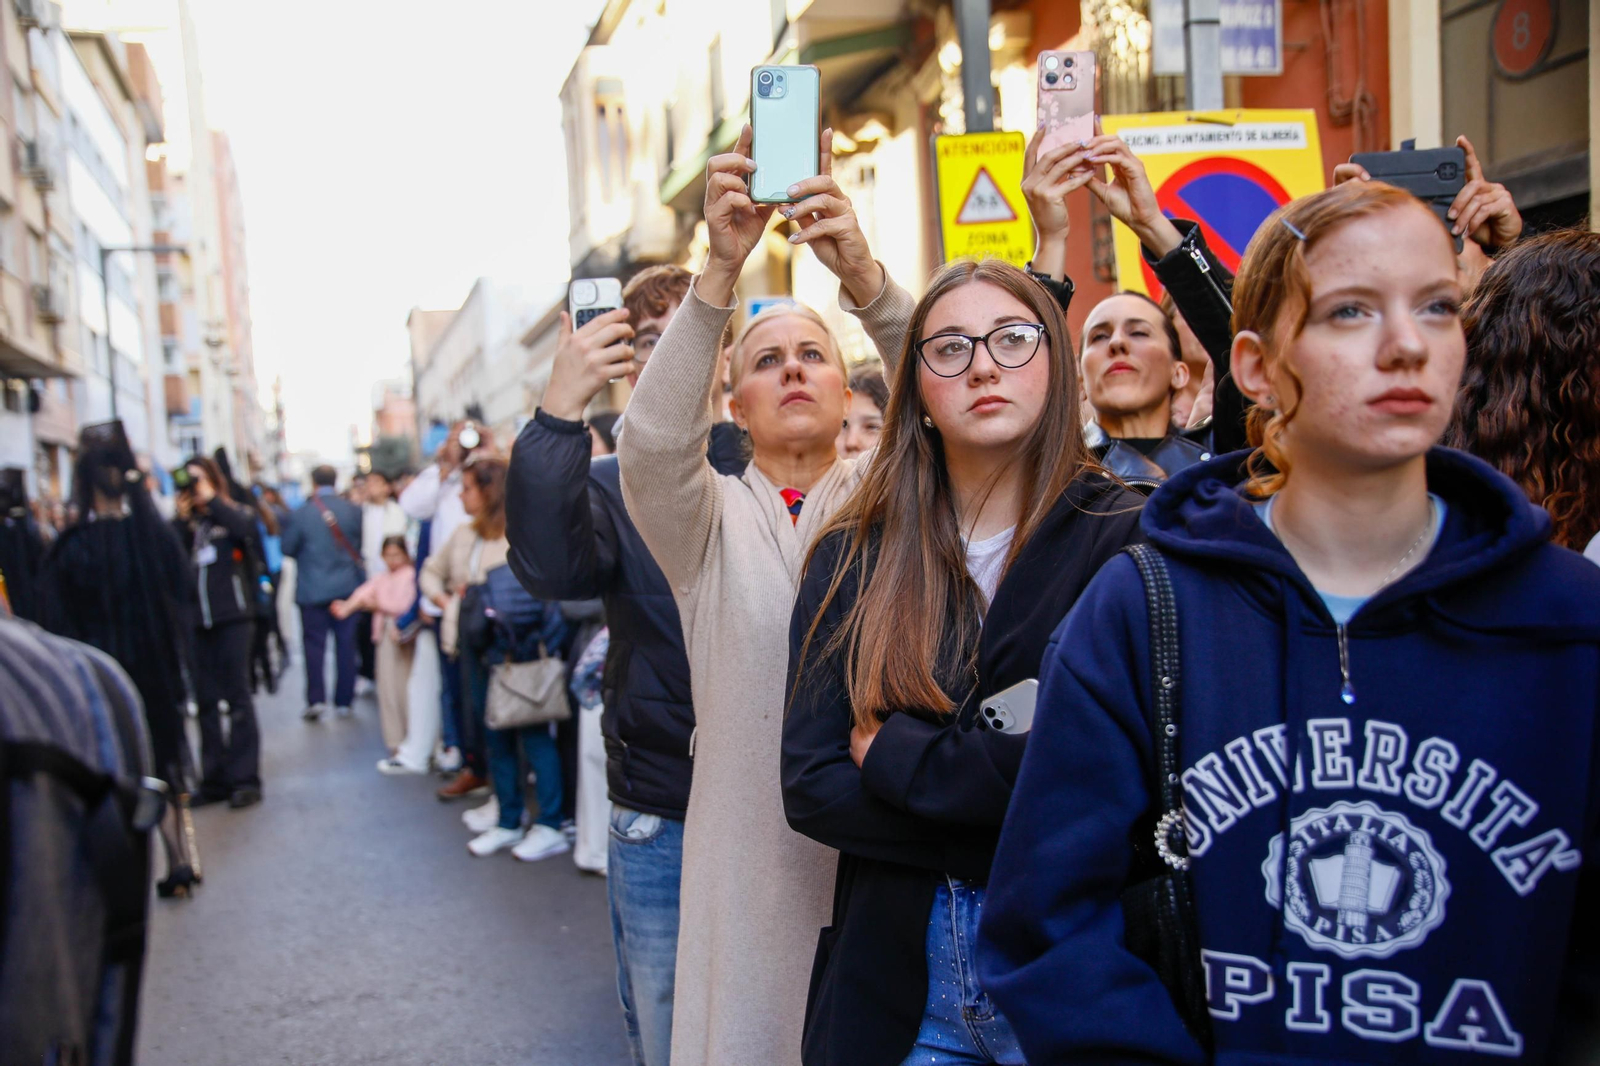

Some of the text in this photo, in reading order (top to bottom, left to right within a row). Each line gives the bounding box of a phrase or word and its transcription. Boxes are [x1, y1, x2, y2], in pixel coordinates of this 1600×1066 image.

[1512, 11, 1530, 50] 8
[1166, 130, 1241, 145] AYUNTAMIENTO
[1246, 130, 1258, 142] DE
[967, 231, 1008, 247] ZONA
[1299, 813, 1408, 854] ITALIA
[1312, 915, 1394, 945] PISA
[1200, 947, 1524, 1057] PISA
